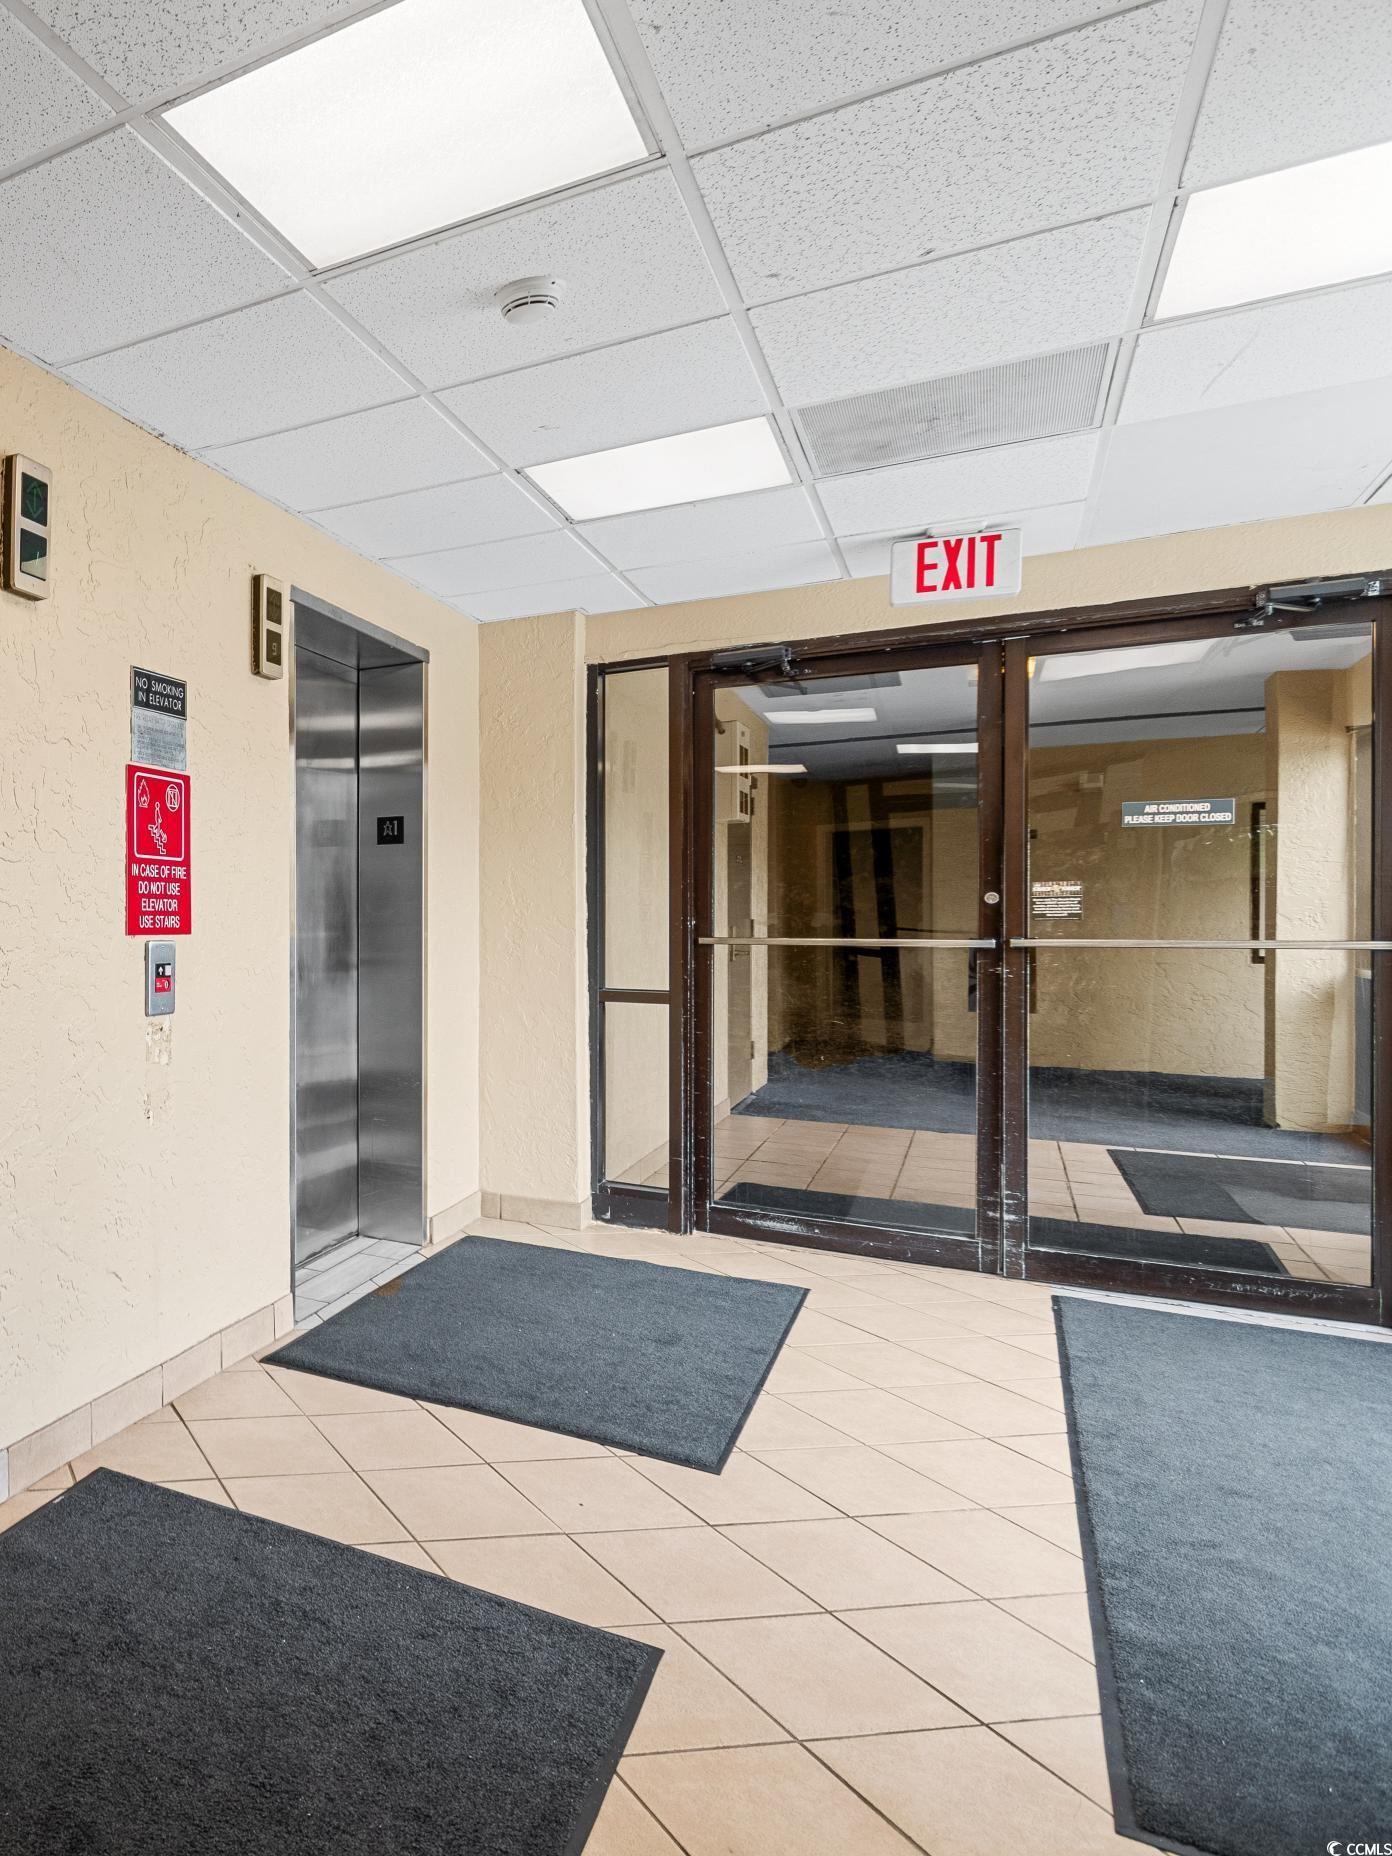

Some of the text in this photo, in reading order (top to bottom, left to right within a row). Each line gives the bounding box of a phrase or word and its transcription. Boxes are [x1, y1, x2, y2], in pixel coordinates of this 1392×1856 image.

[916, 534, 1002, 593] EXIT
[135, 676, 184, 699] NO SMOKING
[138, 691, 182, 711] IN ELEVATOR
[1144, 803, 1211, 813] AIR CONDITIONED
[1124, 812, 1232, 824] PLEASE KEEP DOOR CLOSED
[131, 863, 187, 880] IN CASE OF FIRE
[138, 881, 181, 896] DO NOT USE
[141, 898, 178, 911] ELEVATOR
[139, 915, 180, 928] USE STAIRS
